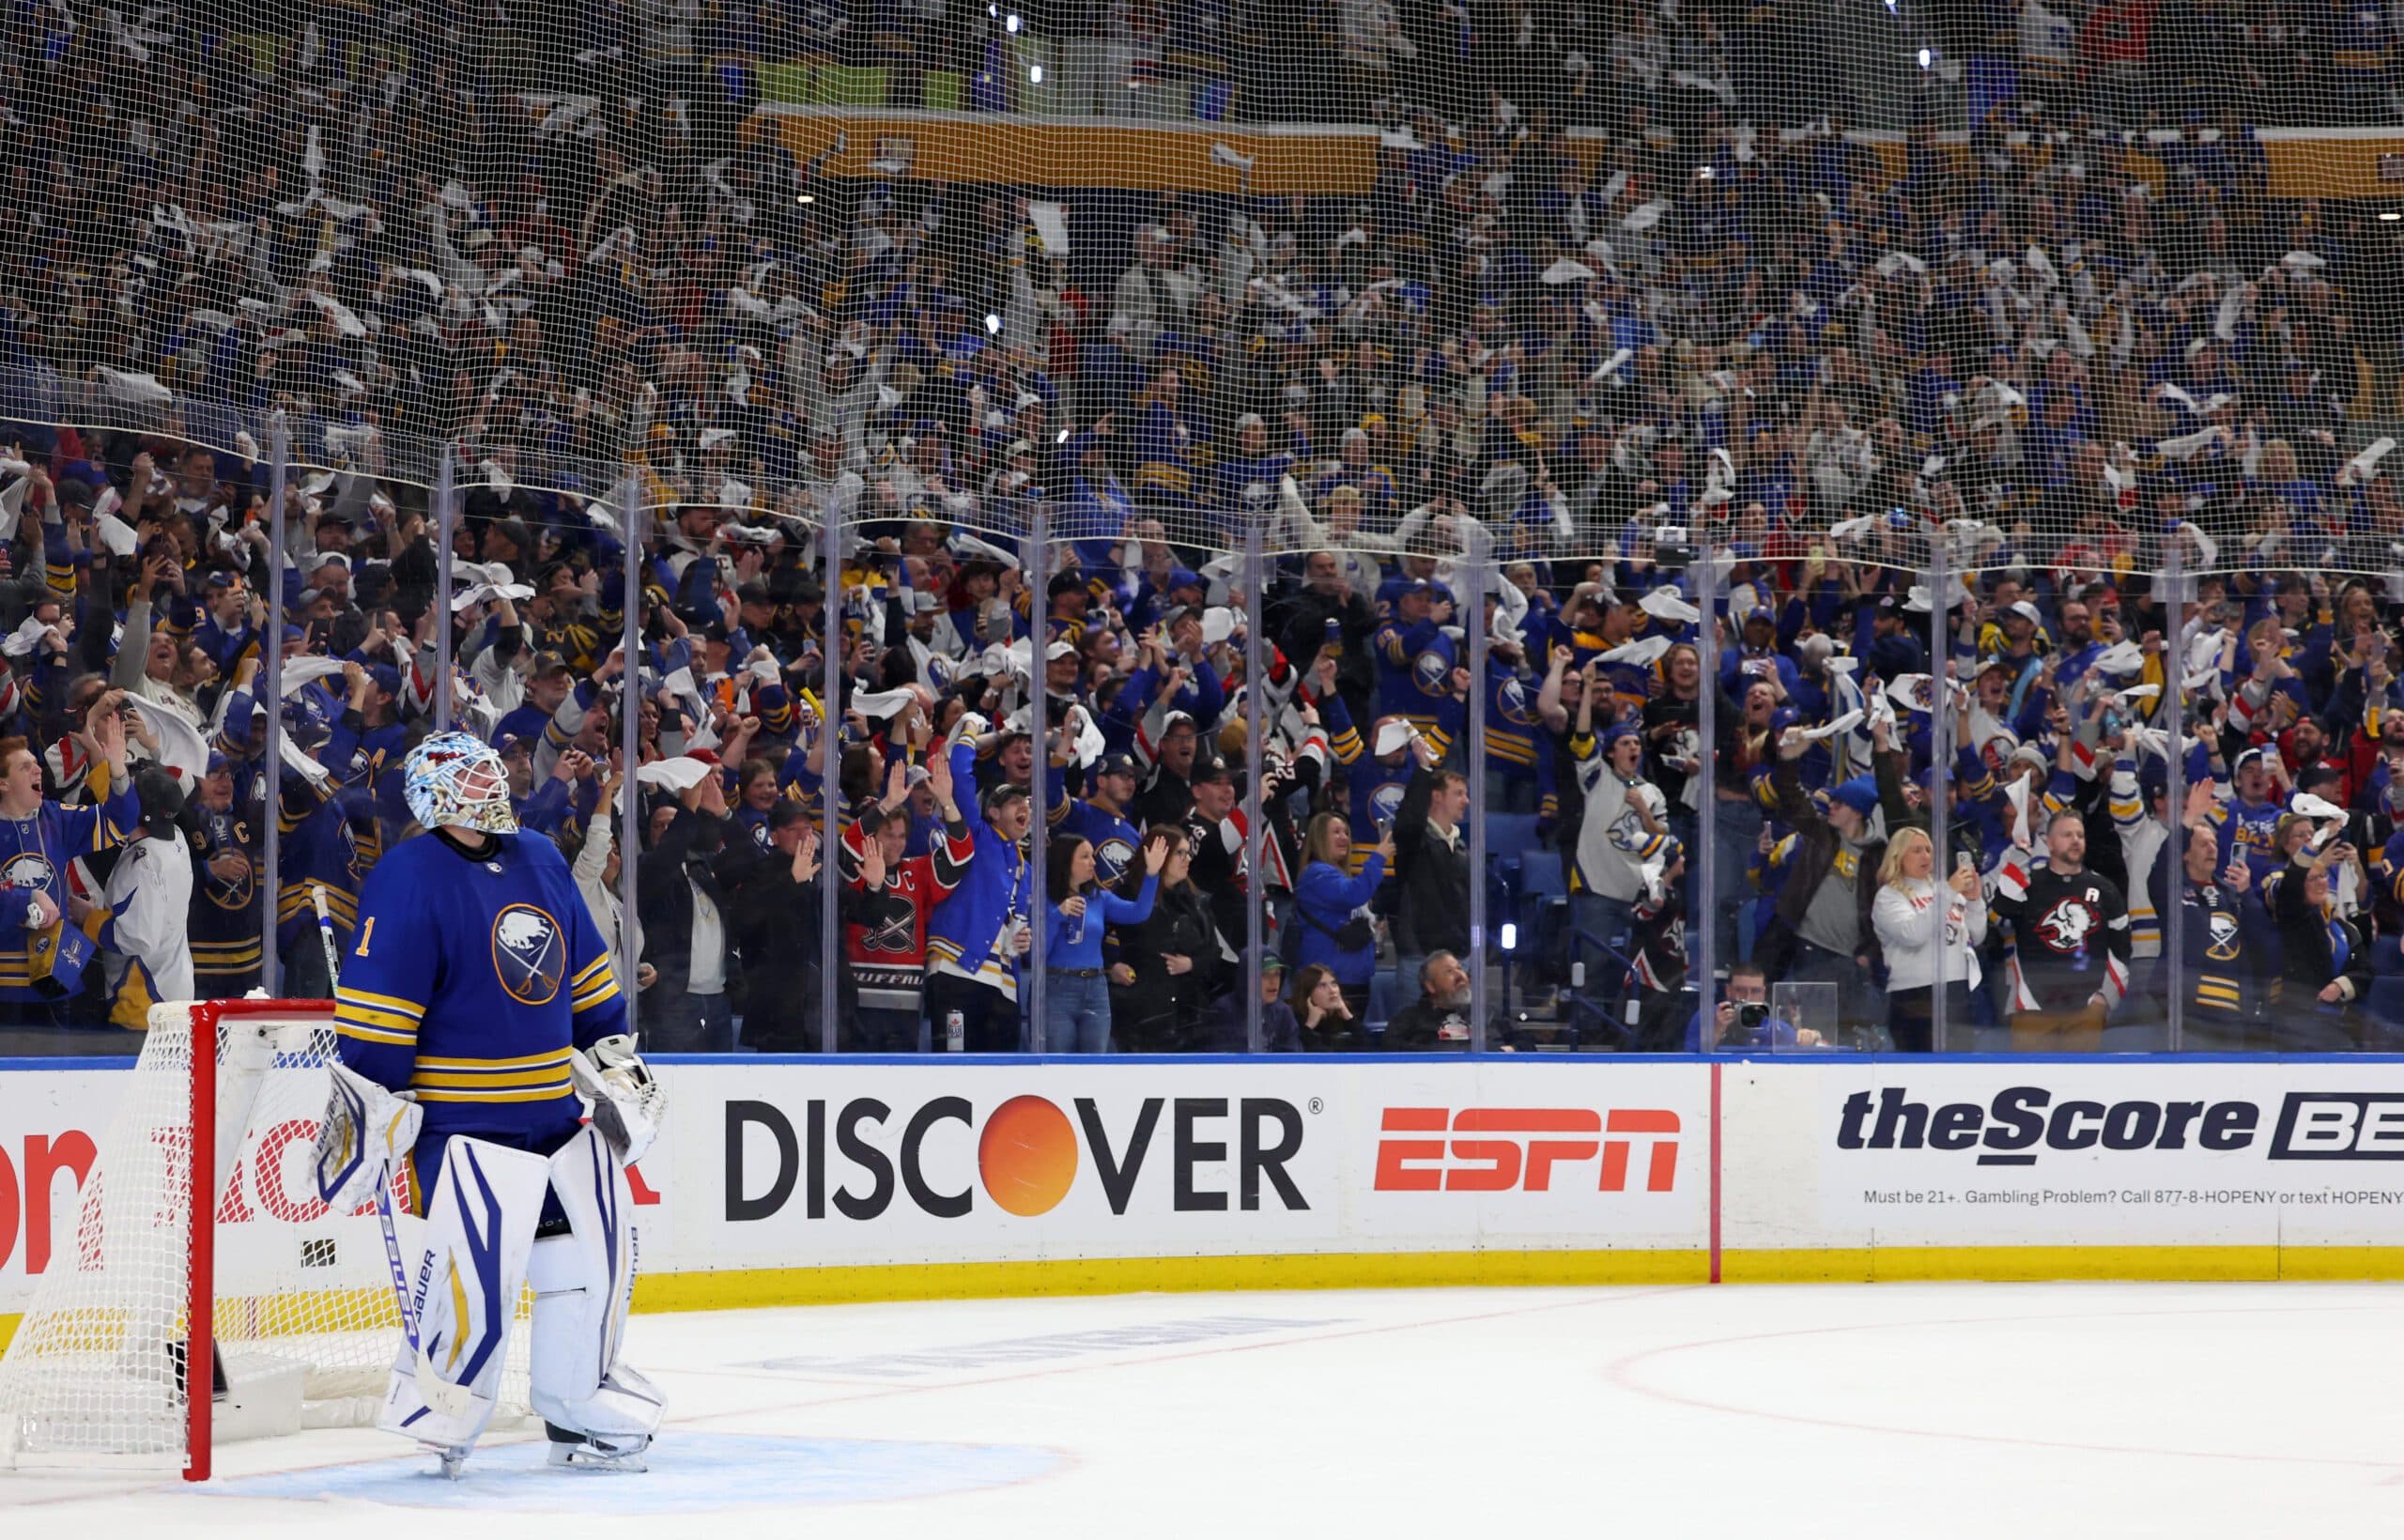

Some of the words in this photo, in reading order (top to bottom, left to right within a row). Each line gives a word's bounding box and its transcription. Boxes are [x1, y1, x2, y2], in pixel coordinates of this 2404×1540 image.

[234, 821, 251, 843] C
[902, 870, 916, 891] C
[355, 916, 376, 958] 1
[1837, 1086, 2259, 1165] theScore
[1374, 1107, 1681, 1192] ESPN
[1864, 1190, 1902, 1204] Must
[1904, 1190, 1924, 1204] be
[1927, 1190, 1962, 1204] 21+.
[1965, 1190, 2040, 1207] Gambling
[2042, 1190, 2118, 1204] Problem?
[2120, 1190, 2150, 1204] Call
[2153, 1190, 2277, 1205] 877-8-HOPENY
[2279, 1190, 2296, 1205] or
[2298, 1190, 2328, 1205] text
[2332, 1190, 2404, 1206] HOPENY
